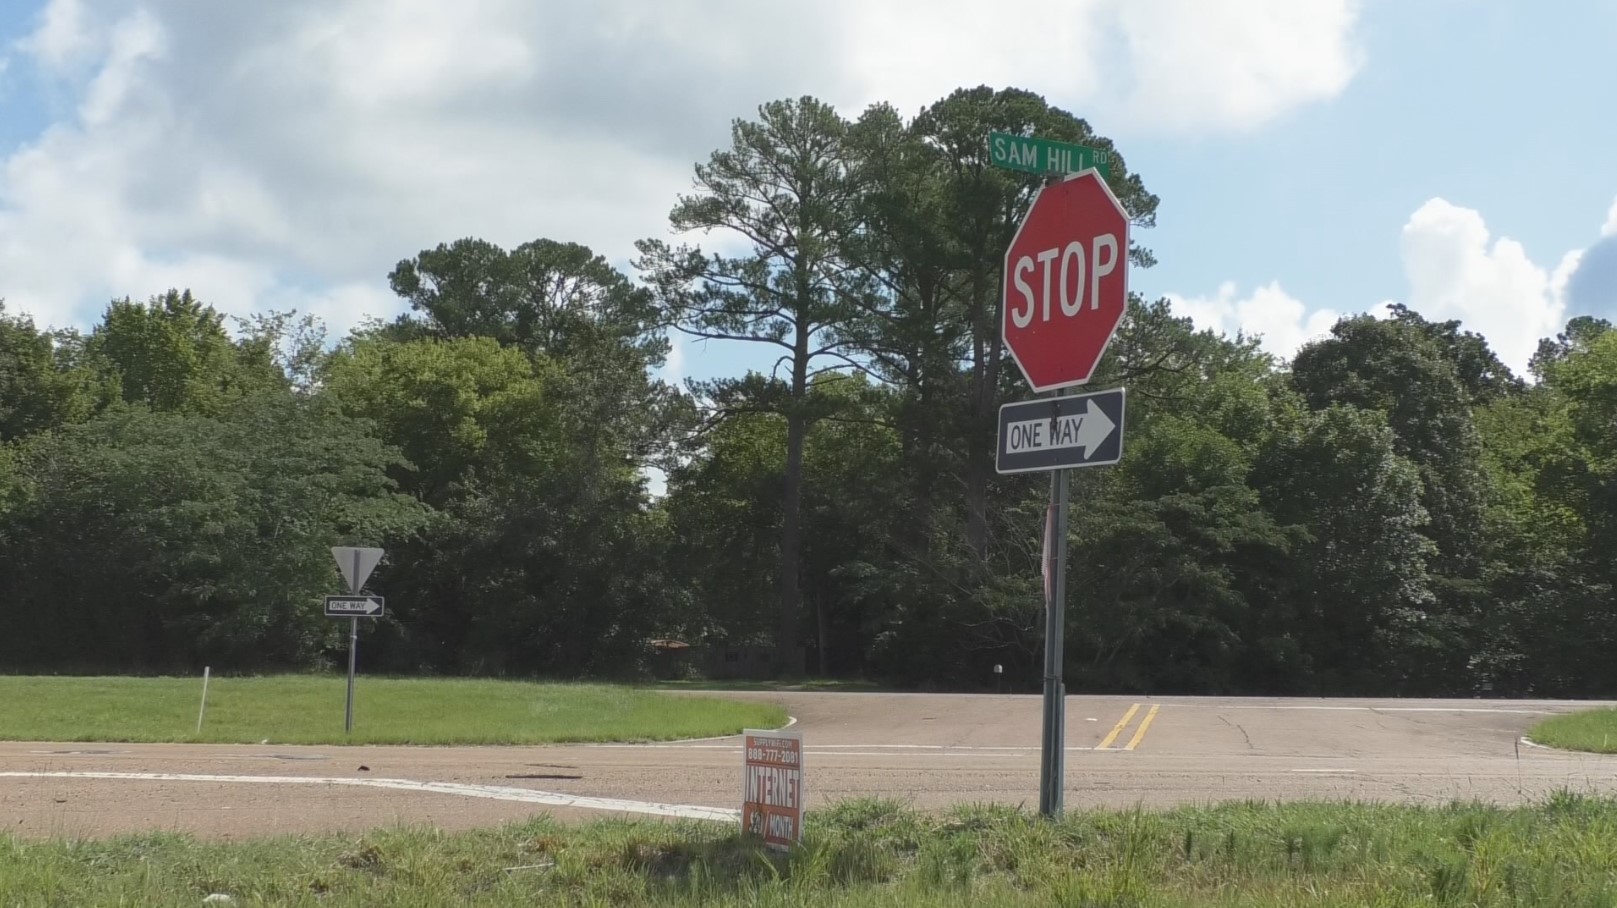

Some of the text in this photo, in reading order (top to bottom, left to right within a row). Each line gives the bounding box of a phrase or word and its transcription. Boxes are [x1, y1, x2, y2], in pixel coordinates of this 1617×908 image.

[994, 137, 1037, 169] SAM
[1092, 150, 1108, 164] RD
[1011, 233, 1118, 328] STOP
[1010, 417, 1083, 450] ONE WAY
[331, 601, 366, 610] ONE WAY
[745, 765, 800, 809] INTERNET
